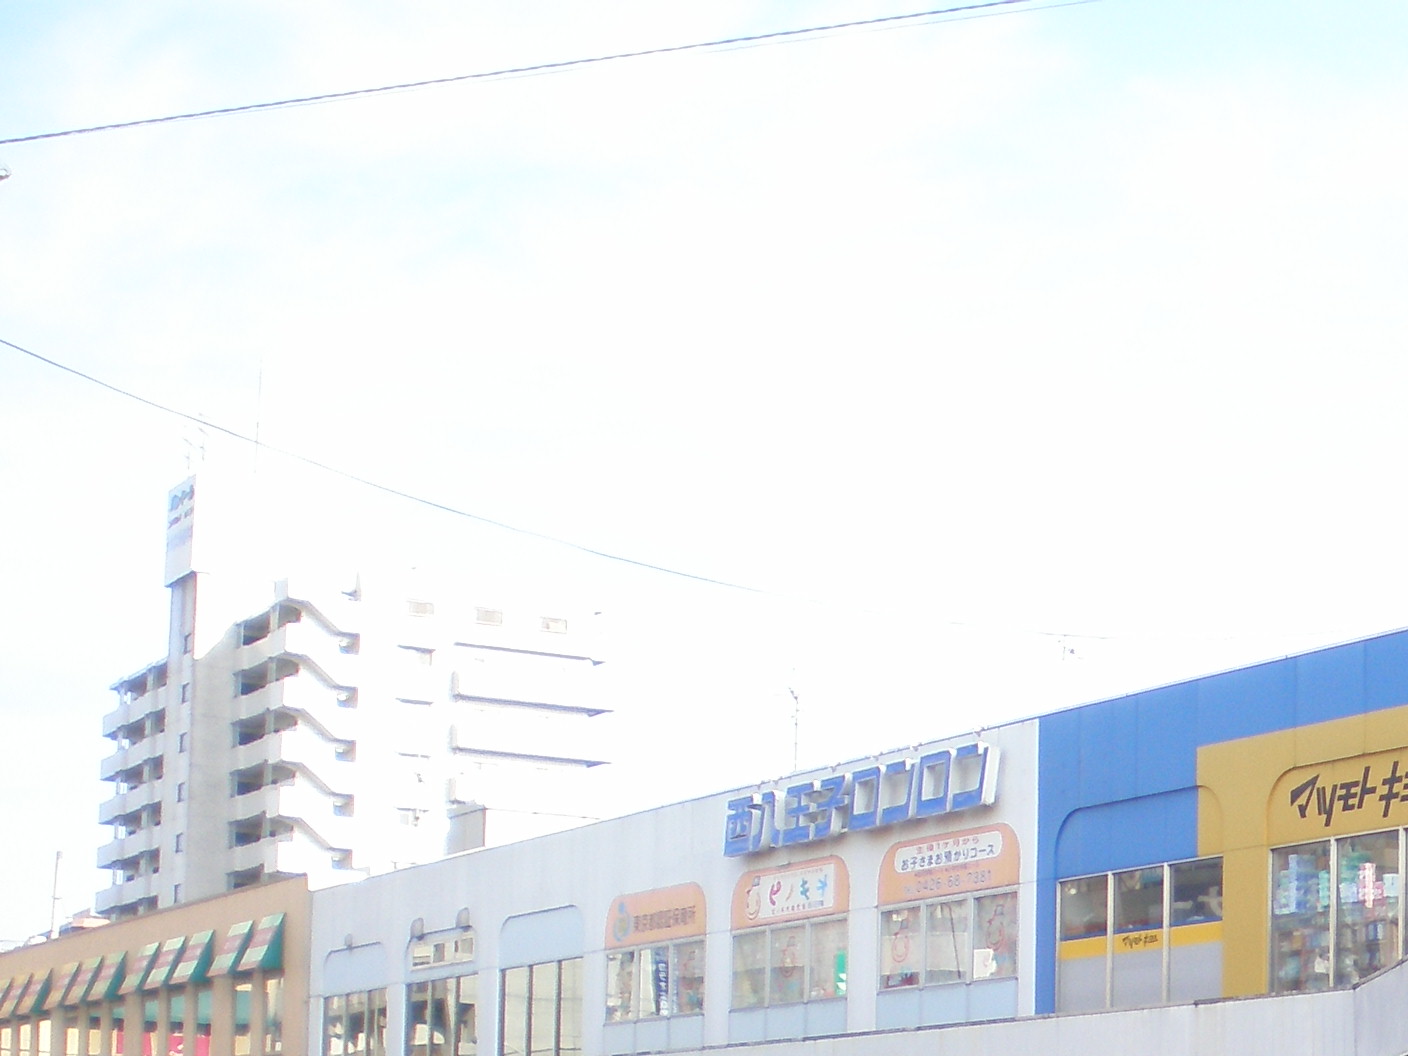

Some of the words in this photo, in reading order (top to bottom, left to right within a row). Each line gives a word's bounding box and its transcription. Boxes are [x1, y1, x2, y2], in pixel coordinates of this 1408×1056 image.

[723, 741, 998, 858] 西八王子ロンロン
